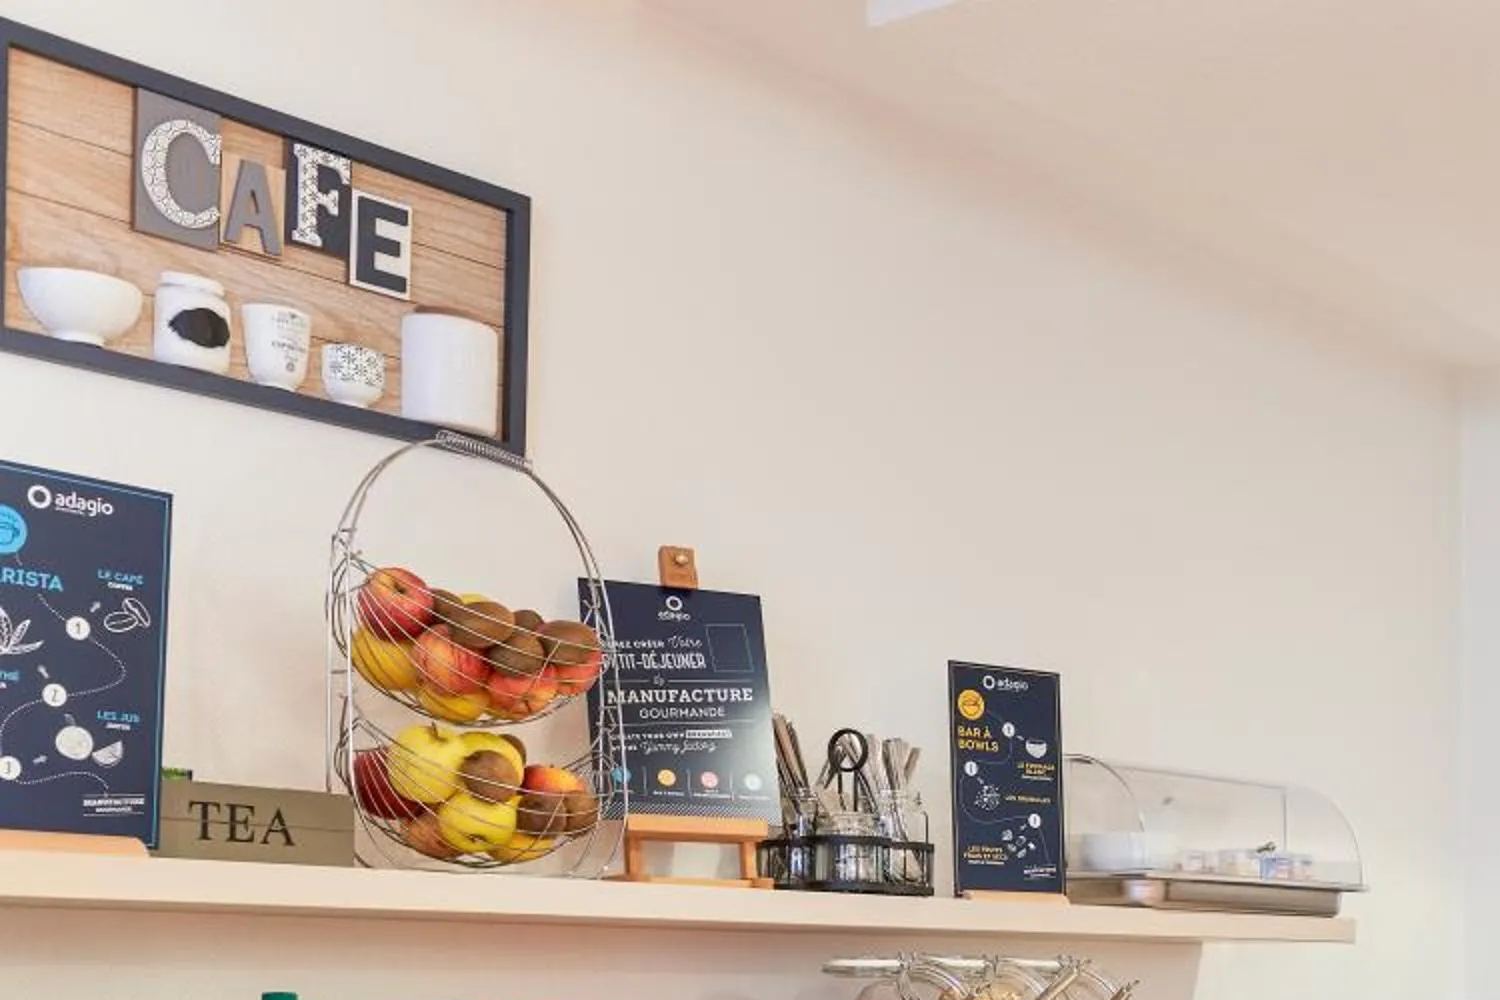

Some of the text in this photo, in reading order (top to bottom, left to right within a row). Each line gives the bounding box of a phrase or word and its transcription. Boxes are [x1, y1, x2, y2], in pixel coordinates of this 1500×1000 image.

[55, 491, 114, 517] adagio
[0, 567, 64, 592] RISTA
[607, 687, 753, 704] MANUFACTURE
[639, 706, 726, 719] GOURMANDE
[958, 725, 992, 738] BAR À
[959, 739, 999, 752] BOWLS
[188, 799, 297, 848] TEA
